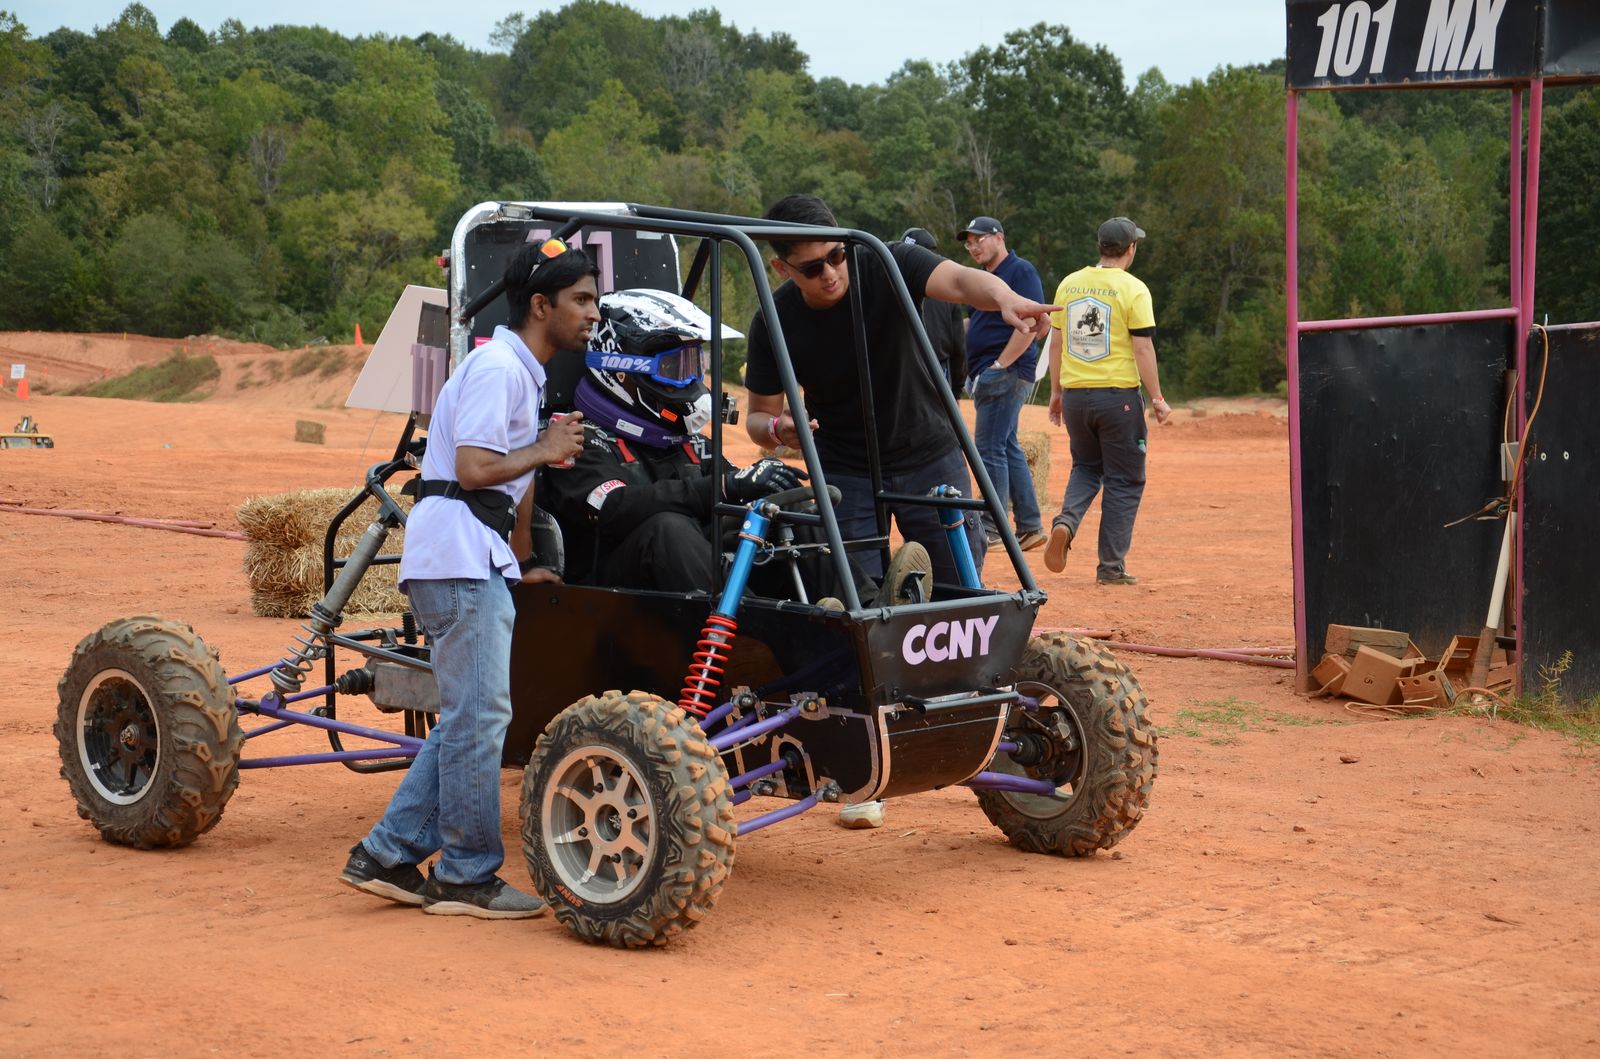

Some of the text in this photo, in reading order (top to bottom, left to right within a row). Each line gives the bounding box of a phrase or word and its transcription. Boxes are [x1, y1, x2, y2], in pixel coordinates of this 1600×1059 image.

[1314, 0, 1505, 78] 101 MX
[1065, 286, 1119, 297] VOLUNTEER
[601, 355, 651, 372] 100%
[902, 615, 1000, 666] CCNY
